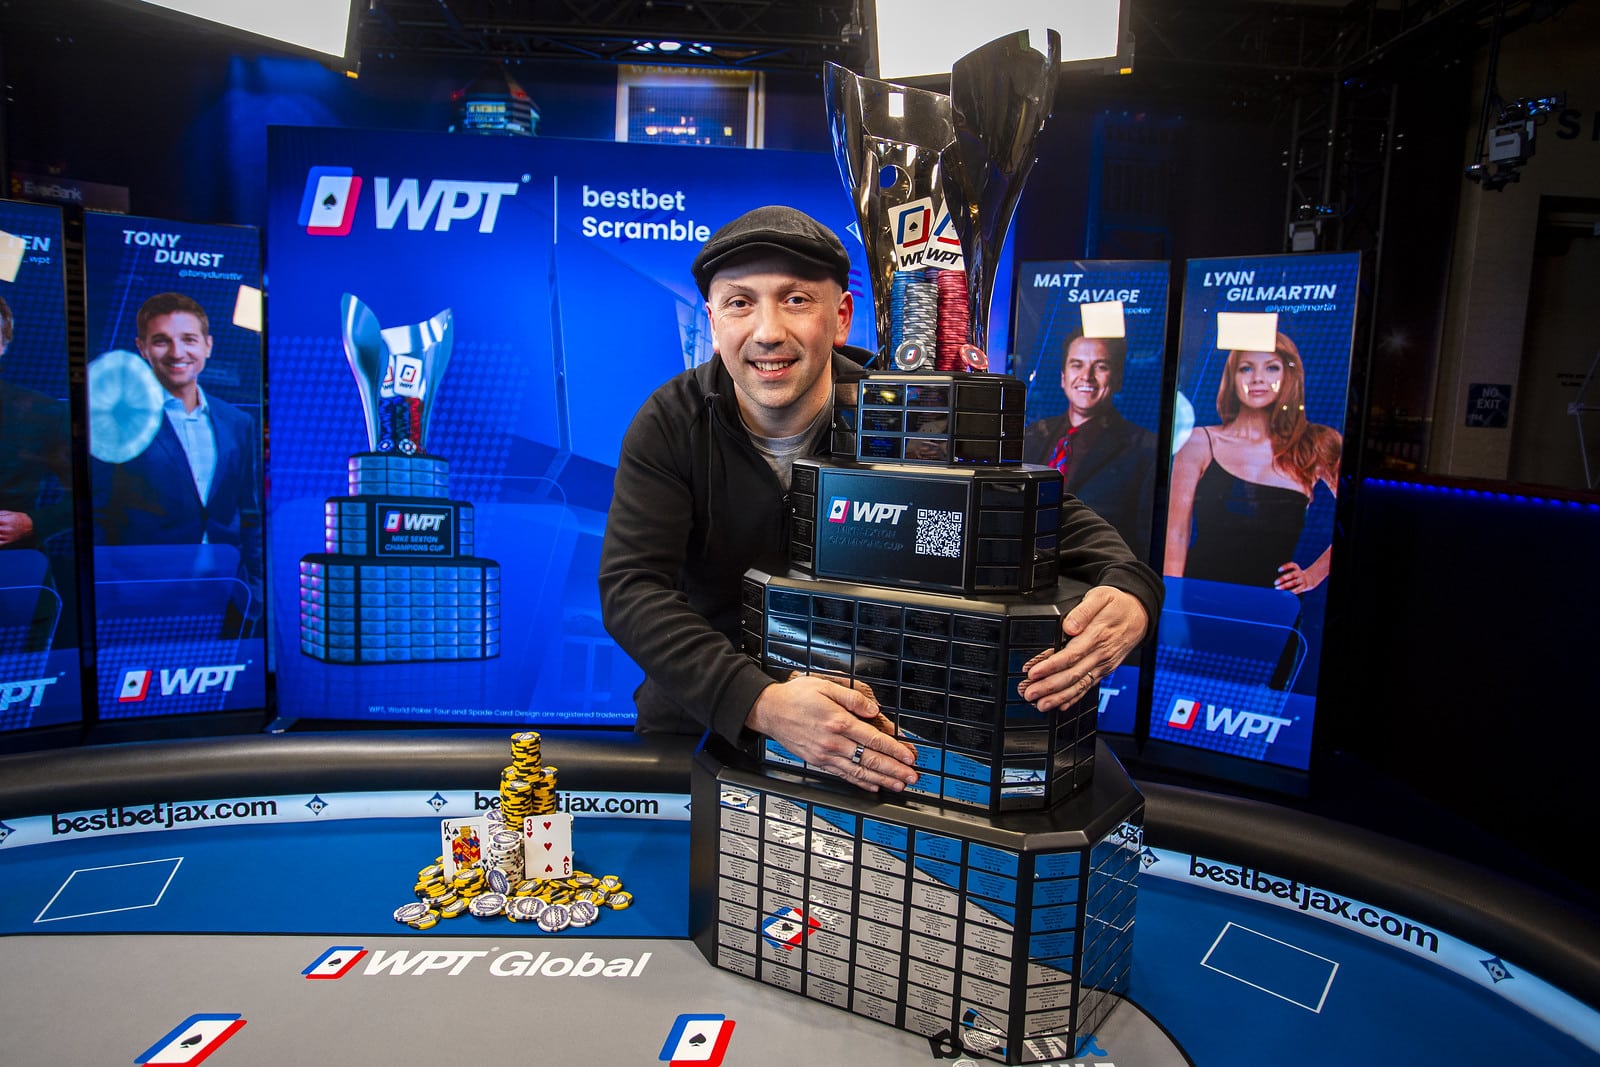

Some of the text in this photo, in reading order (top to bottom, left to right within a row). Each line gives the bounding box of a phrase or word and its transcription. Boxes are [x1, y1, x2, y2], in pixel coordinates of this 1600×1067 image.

[374, 176, 519, 234] WPT
[582, 184, 686, 212] bestbet
[122, 229, 181, 249] TONY
[582, 216, 711, 243] Scramble
[154, 249, 225, 268] DUNST
[925, 247, 964, 265] WPT
[1033, 273, 1083, 288] MATT
[1203, 270, 1256, 288] LYNN
[1068, 288, 1140, 304] SAVAGE
[1226, 284, 1337, 302] GILMARTIN
[1482, 387, 1499, 398] NO
[1477, 398, 1501, 409] EXIT
[403, 512, 446, 531] WPT
[853, 501, 908, 525] WPT
[160, 664, 246, 696] WPT
[468, 709, 492, 717] Spade
[514, 710, 540, 718] Design
[1206, 704, 1292, 744] WPT
[474, 791, 659, 815] betjax.com
[51, 799, 278, 835] bestbetjax.com
[526, 818, 533, 831] 3
[443, 822, 451, 834] K
[563, 862, 570, 875] 3
[1190, 855, 1439, 953] bestbetjax.com
[363, 950, 652, 977] WPT Global
